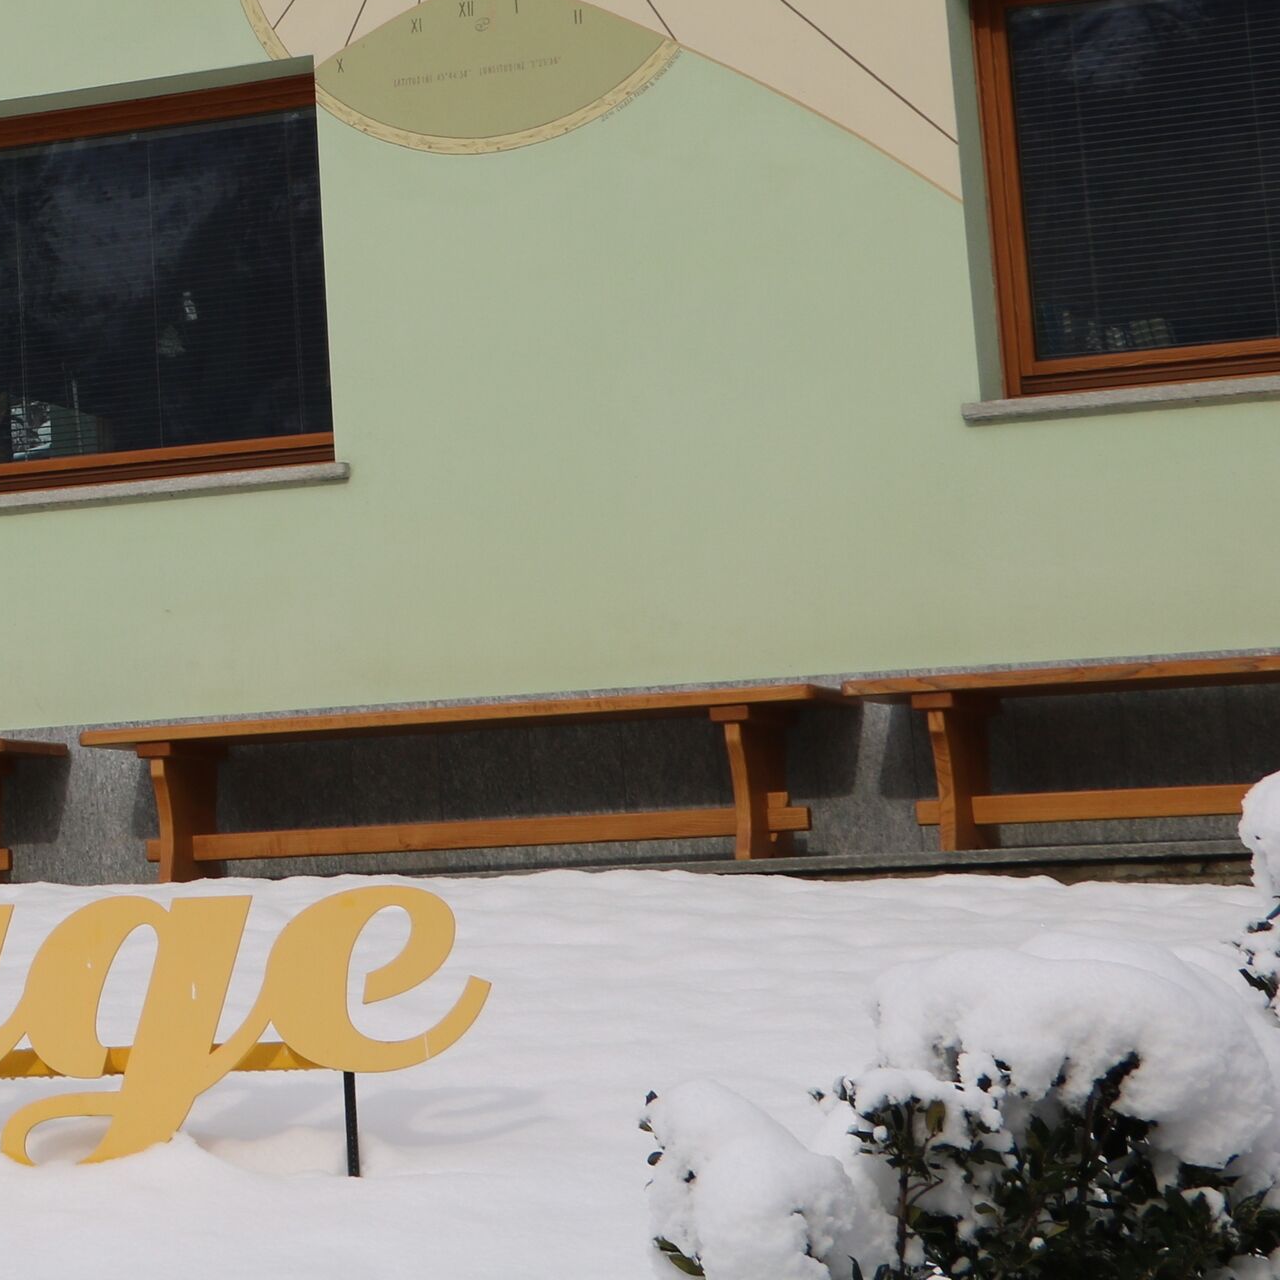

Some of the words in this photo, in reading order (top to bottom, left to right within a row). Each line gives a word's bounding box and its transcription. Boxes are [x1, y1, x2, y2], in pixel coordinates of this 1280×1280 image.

[335, 59, 345, 73] X
[411, 17, 423, 34] XI
[458, 0, 474, 17] XII
